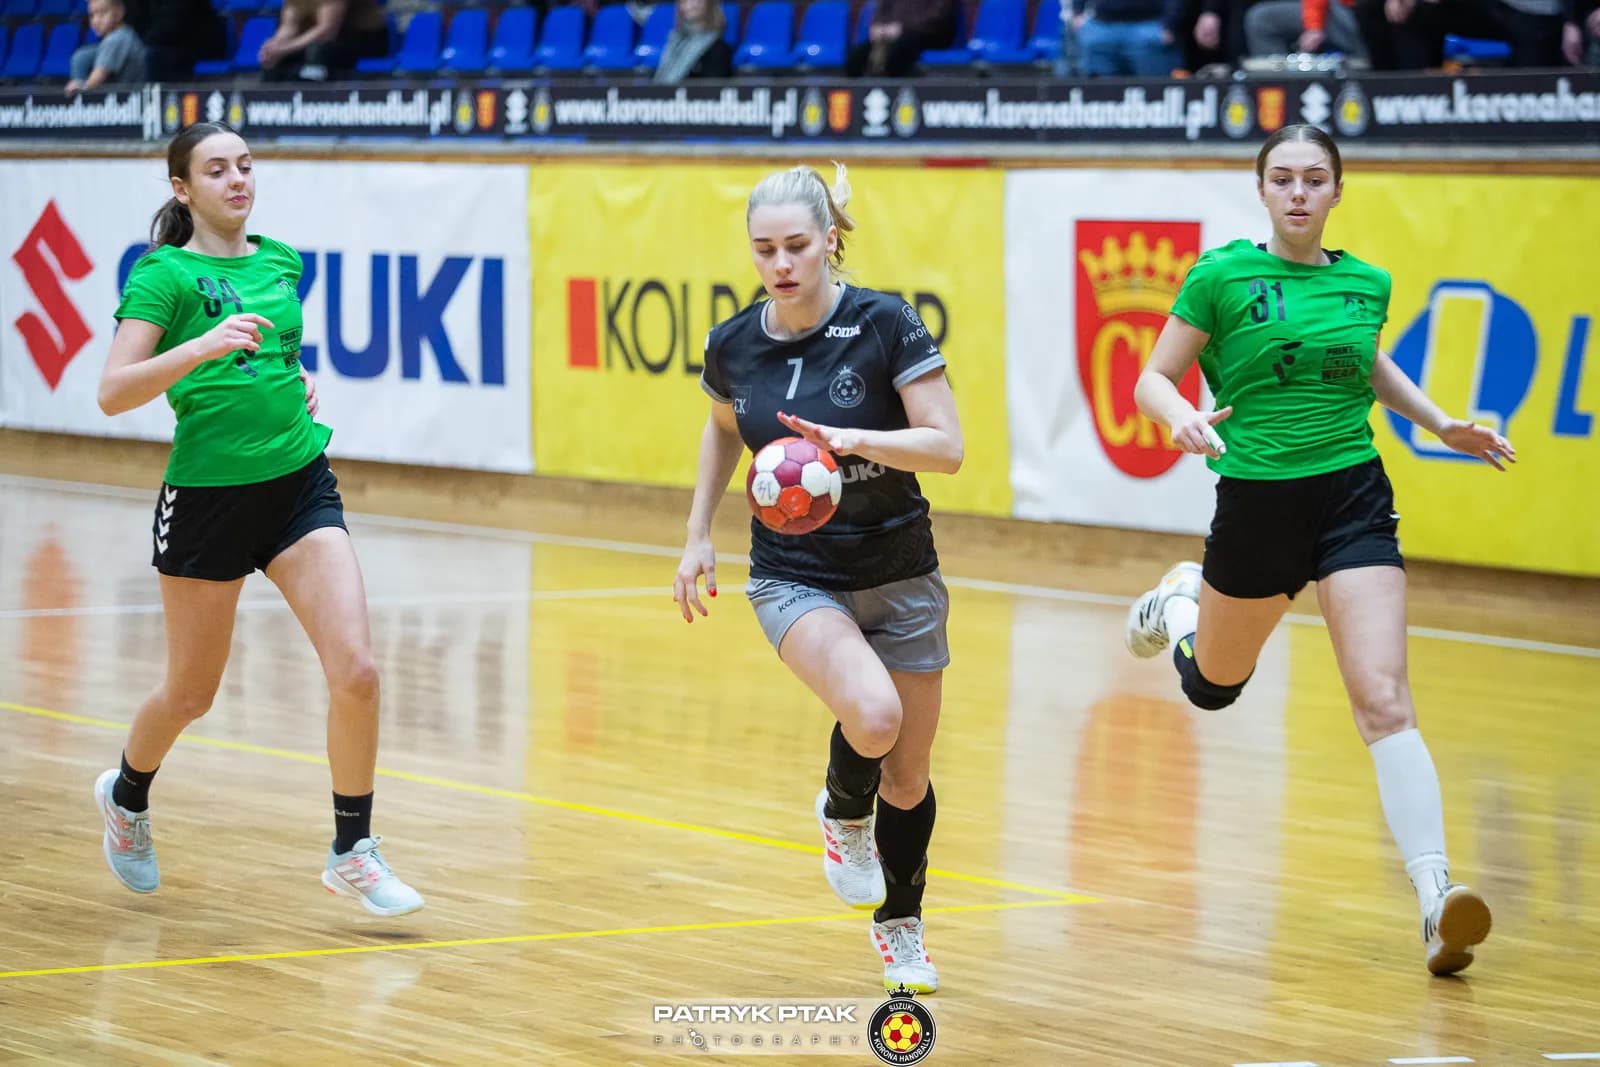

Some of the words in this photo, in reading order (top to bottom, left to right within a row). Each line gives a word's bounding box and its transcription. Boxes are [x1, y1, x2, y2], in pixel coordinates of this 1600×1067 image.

[196, 276, 243, 318] 34
[1249, 279, 1286, 324] 31
[786, 357, 804, 400] 7
